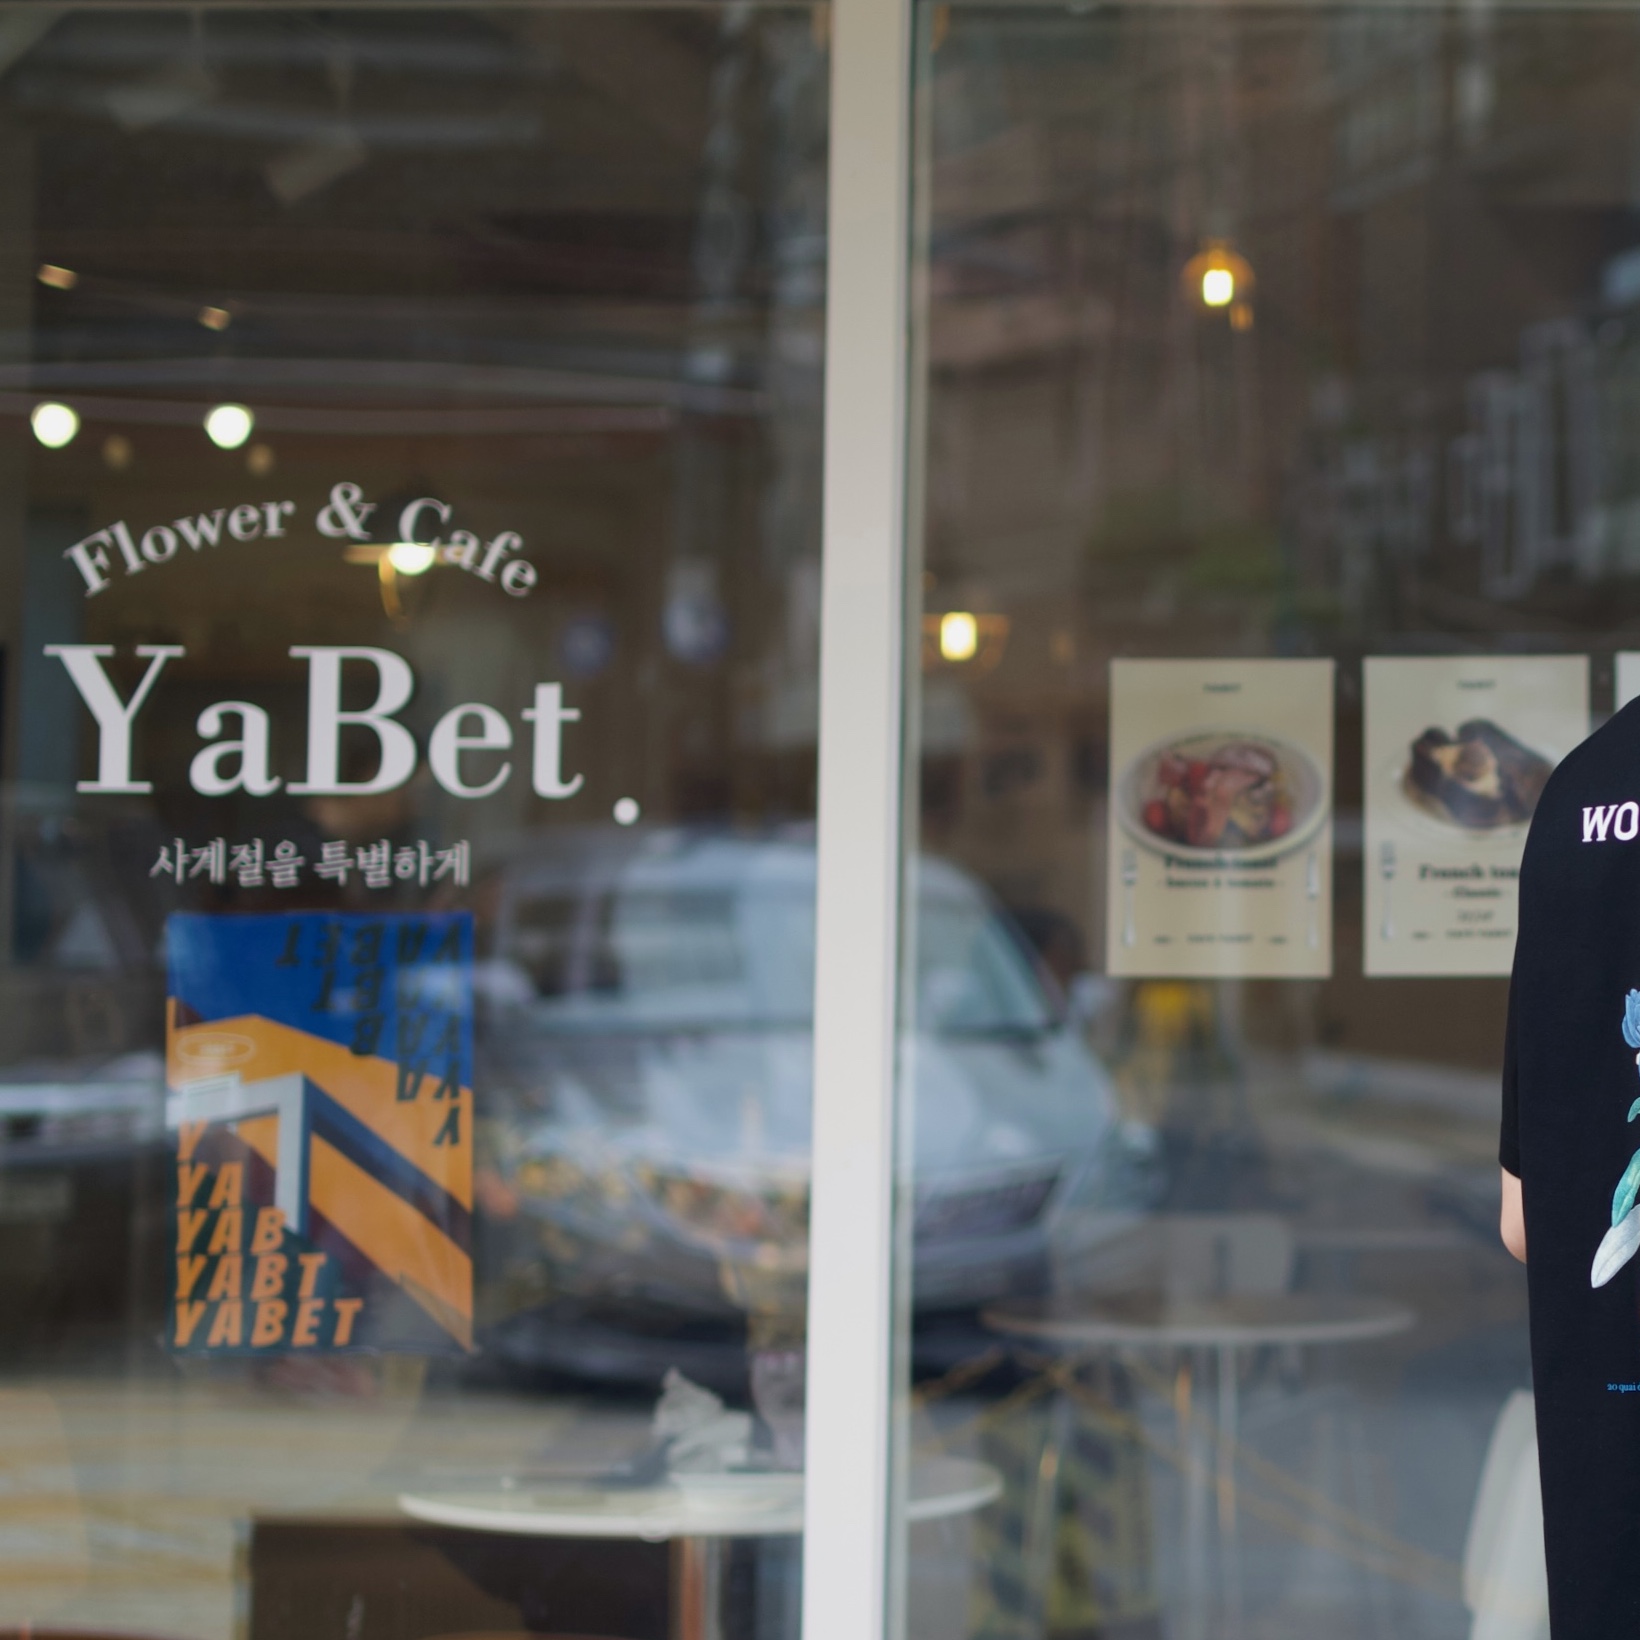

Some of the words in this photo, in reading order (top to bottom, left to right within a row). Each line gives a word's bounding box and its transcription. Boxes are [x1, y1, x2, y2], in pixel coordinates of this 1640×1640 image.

[64, 501, 295, 598] Flower
[316, 481, 376, 540] &
[398, 497, 538, 598] Cafe
[149, 838, 305, 886] 사계절을
[313, 838, 471, 887] 특별하게
[176, 1162, 243, 1209] YA
[176, 1206, 286, 1255] YAB
[175, 1252, 327, 1300] YABT
[174, 1297, 364, 1348] YABET
